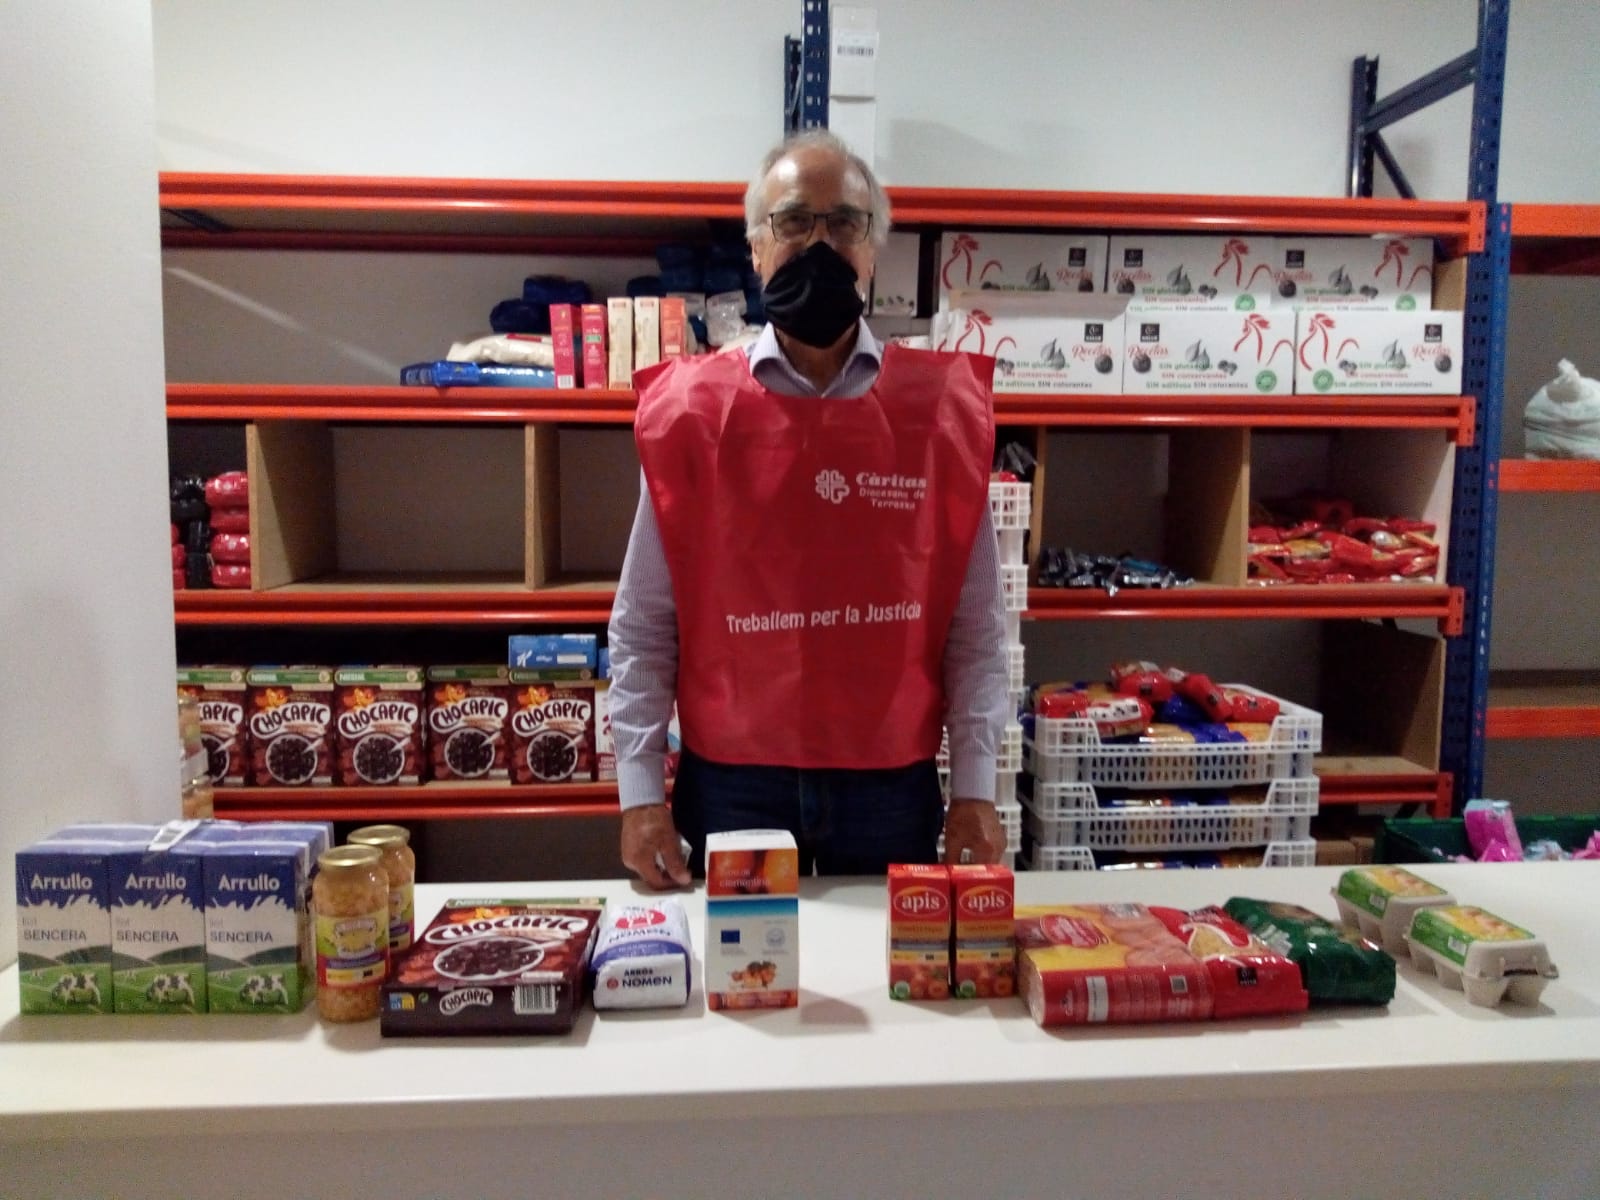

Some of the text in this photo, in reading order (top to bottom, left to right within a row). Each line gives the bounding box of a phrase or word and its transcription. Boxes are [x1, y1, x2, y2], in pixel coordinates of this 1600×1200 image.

[725, 611, 805, 635] Treballem
[810, 607, 840, 627] per
[845, 603, 860, 625] la
[251, 703, 329, 736] CHOCAPIC
[340, 703, 416, 735] CHOCAPIC
[432, 699, 505, 731] CHOCAPIC
[514, 701, 589, 732] CHOCAPIC
[30, 872, 93, 891] Arrullo
[124, 872, 187, 890] Arrullo
[218, 873, 280, 891] Arrullo
[901, 890, 940, 913] apis
[967, 890, 1006, 913] apis
[24, 929, 87, 941] SENCERA
[116, 930, 180, 943] SENCERA
[209, 931, 273, 943] SENCERA
[427, 916, 584, 942] CHOCAPIC
[441, 988, 491, 1012] CHOCAPIC
